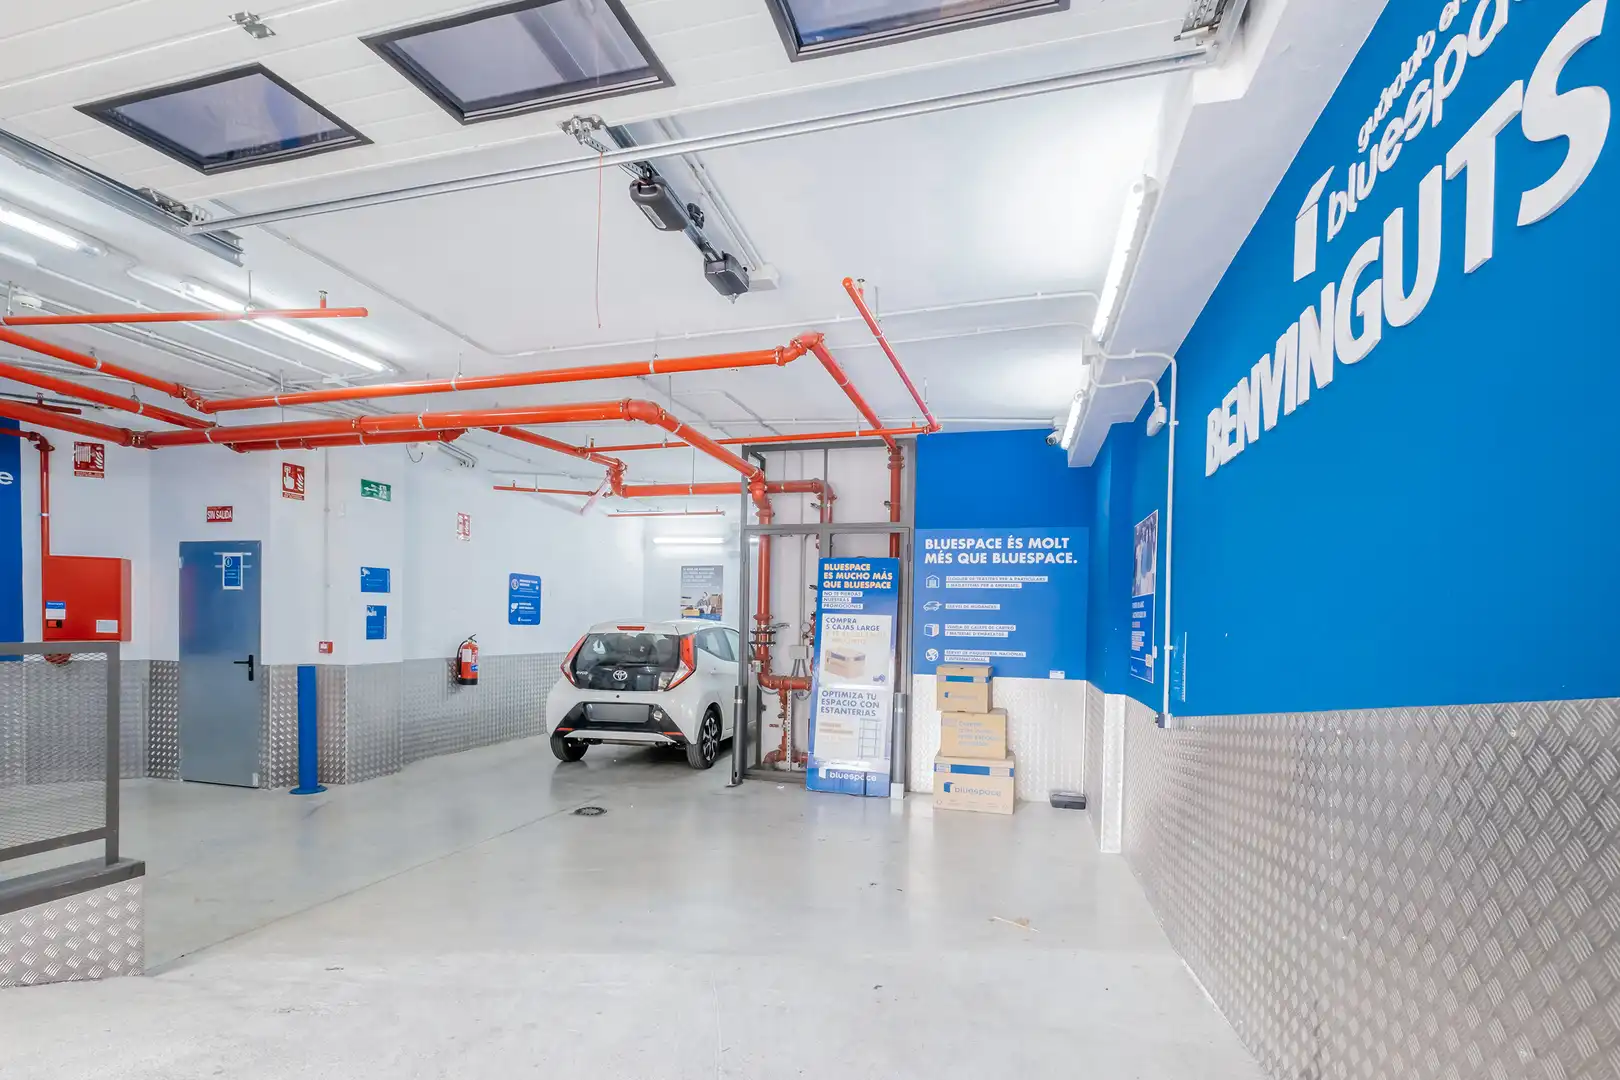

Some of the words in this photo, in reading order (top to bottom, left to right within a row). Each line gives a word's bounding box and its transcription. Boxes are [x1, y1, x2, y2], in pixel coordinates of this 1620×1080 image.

[1205, 0, 1611, 477] BENVINGUTS
[216, 510, 232, 520] SALIDA
[924, 538, 1002, 550] BLUESPACE
[1007, 535, 1024, 549] ÉS
[1028, 538, 1070, 549] MOLT
[924, 550, 953, 564] MÉS
[958, 552, 988, 564] QUE
[992, 552, 1078, 564] BLUESPACE.
[872, 571, 893, 580] MÁS
[844, 581, 892, 589] BLUESPACE
[822, 690, 864, 699] OPTIMIZA
[822, 698, 857, 707] ESPACIO
[820, 706, 877, 716] ESTANTERIAS
